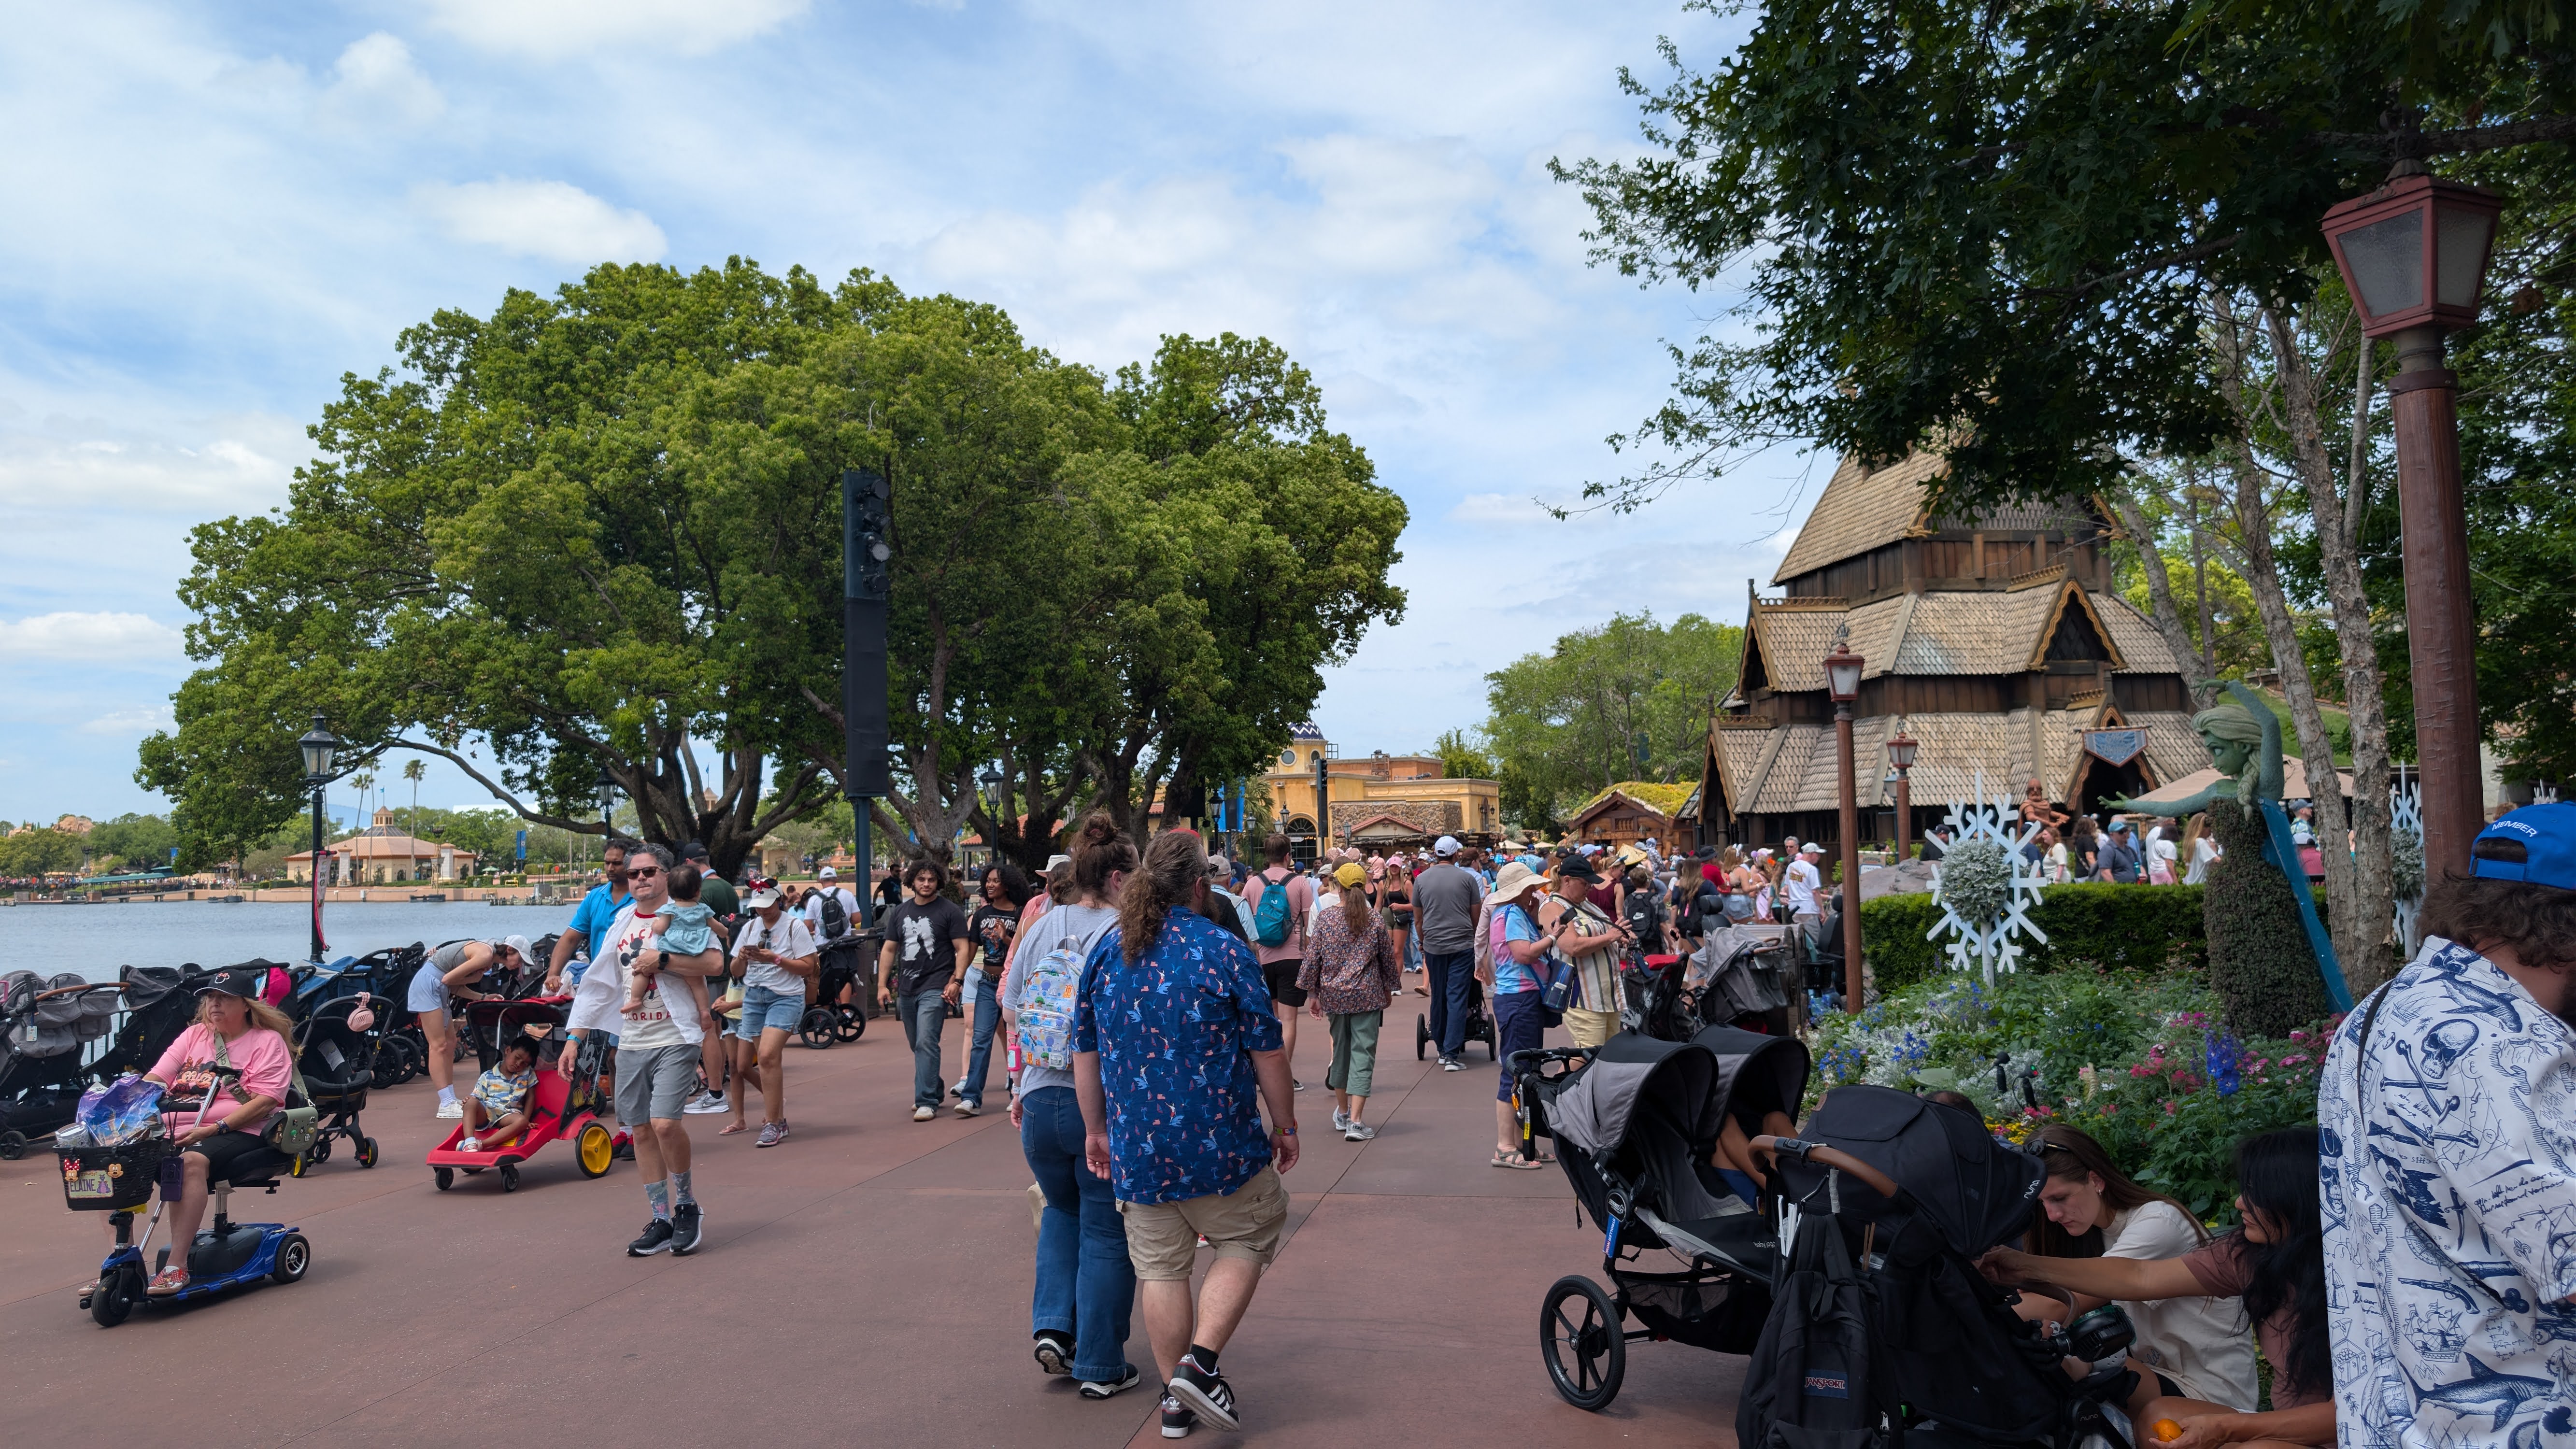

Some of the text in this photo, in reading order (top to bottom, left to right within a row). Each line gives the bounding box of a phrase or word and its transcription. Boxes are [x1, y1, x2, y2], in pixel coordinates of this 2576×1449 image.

[2491, 821, 2537, 838] MEMBER
[70, 1179, 96, 1192] ELAINE
[2023, 1179, 2041, 1199] nuna
[1608, 1218, 1616, 1241] STROLLER
[1804, 1377, 1845, 1390] JANSPORT
[2079, 1413, 2098, 1422] nuna
